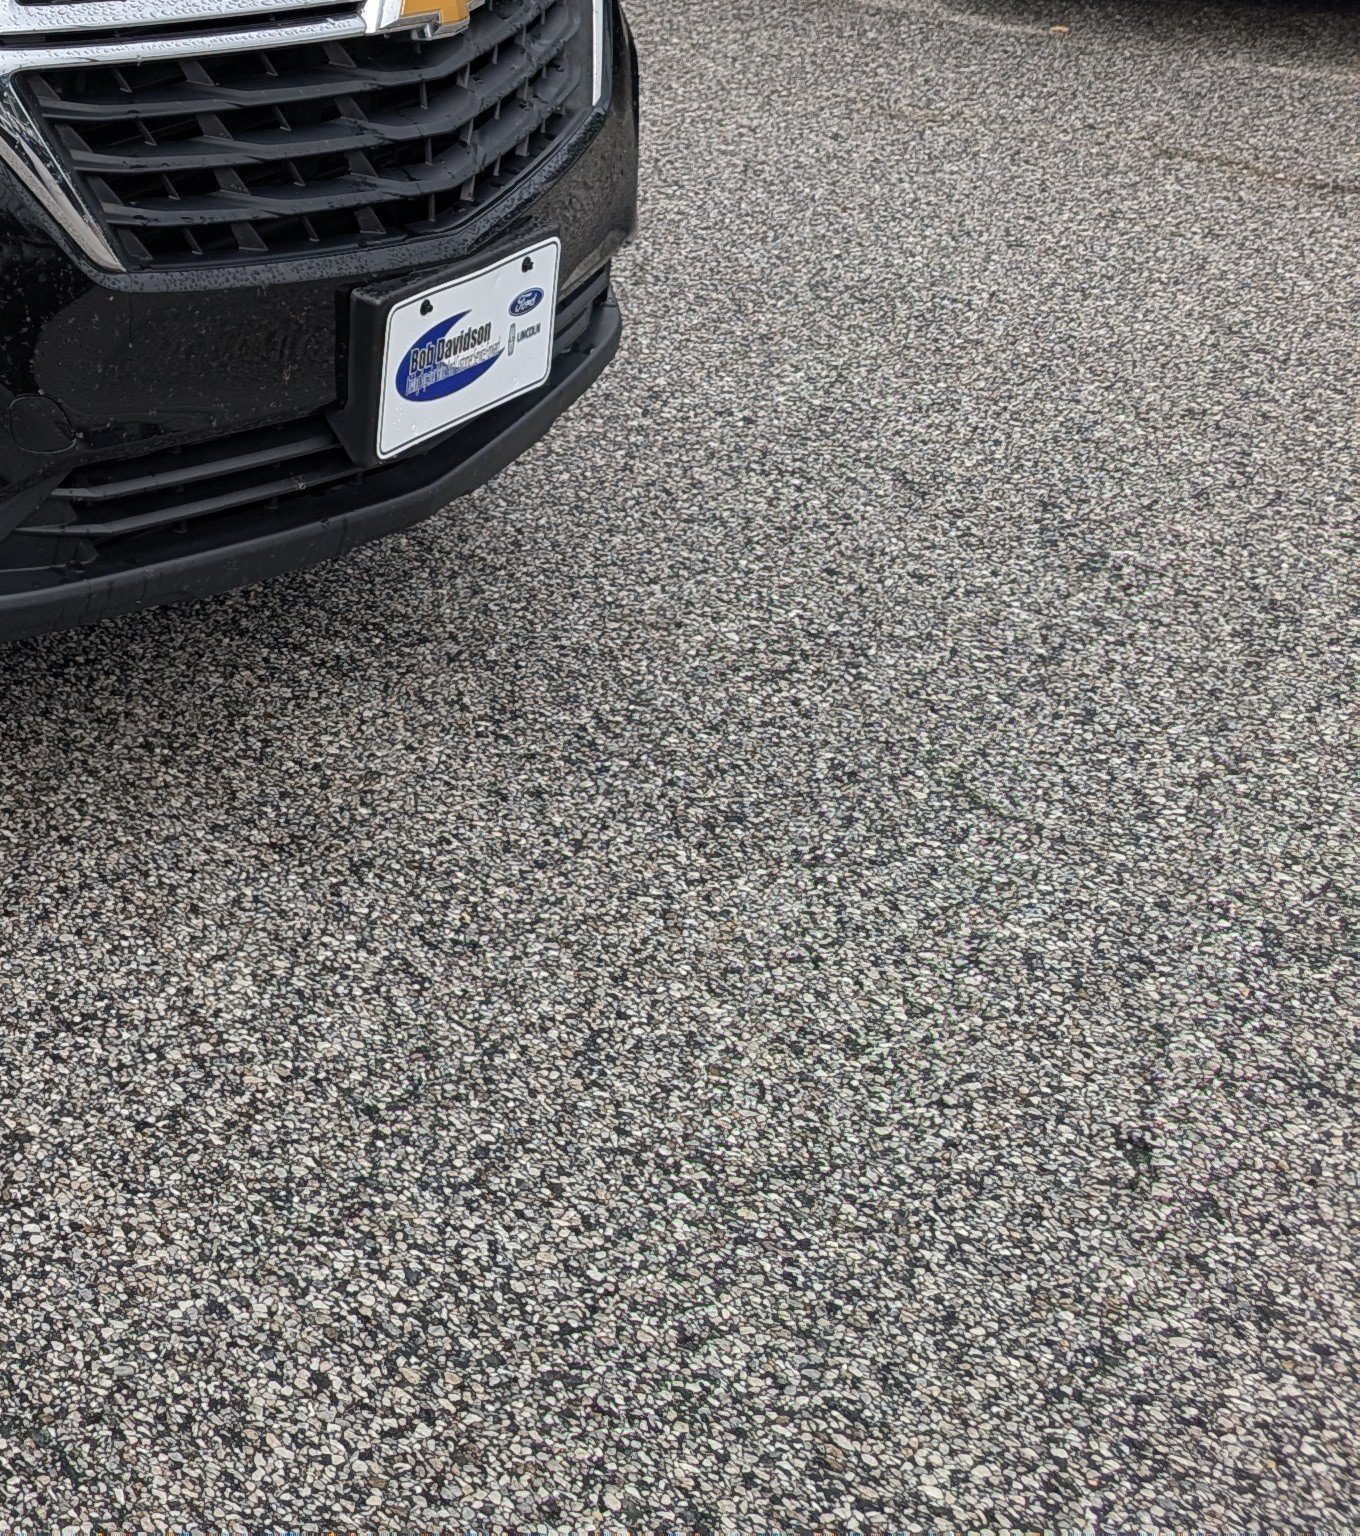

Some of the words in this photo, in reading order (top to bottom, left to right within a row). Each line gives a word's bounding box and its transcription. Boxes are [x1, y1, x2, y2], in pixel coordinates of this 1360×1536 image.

[514, 290, 542, 313] Ford
[516, 322, 542, 343] LINCOLN
[410, 342, 436, 374] Bob
[437, 321, 492, 361] Davidson
